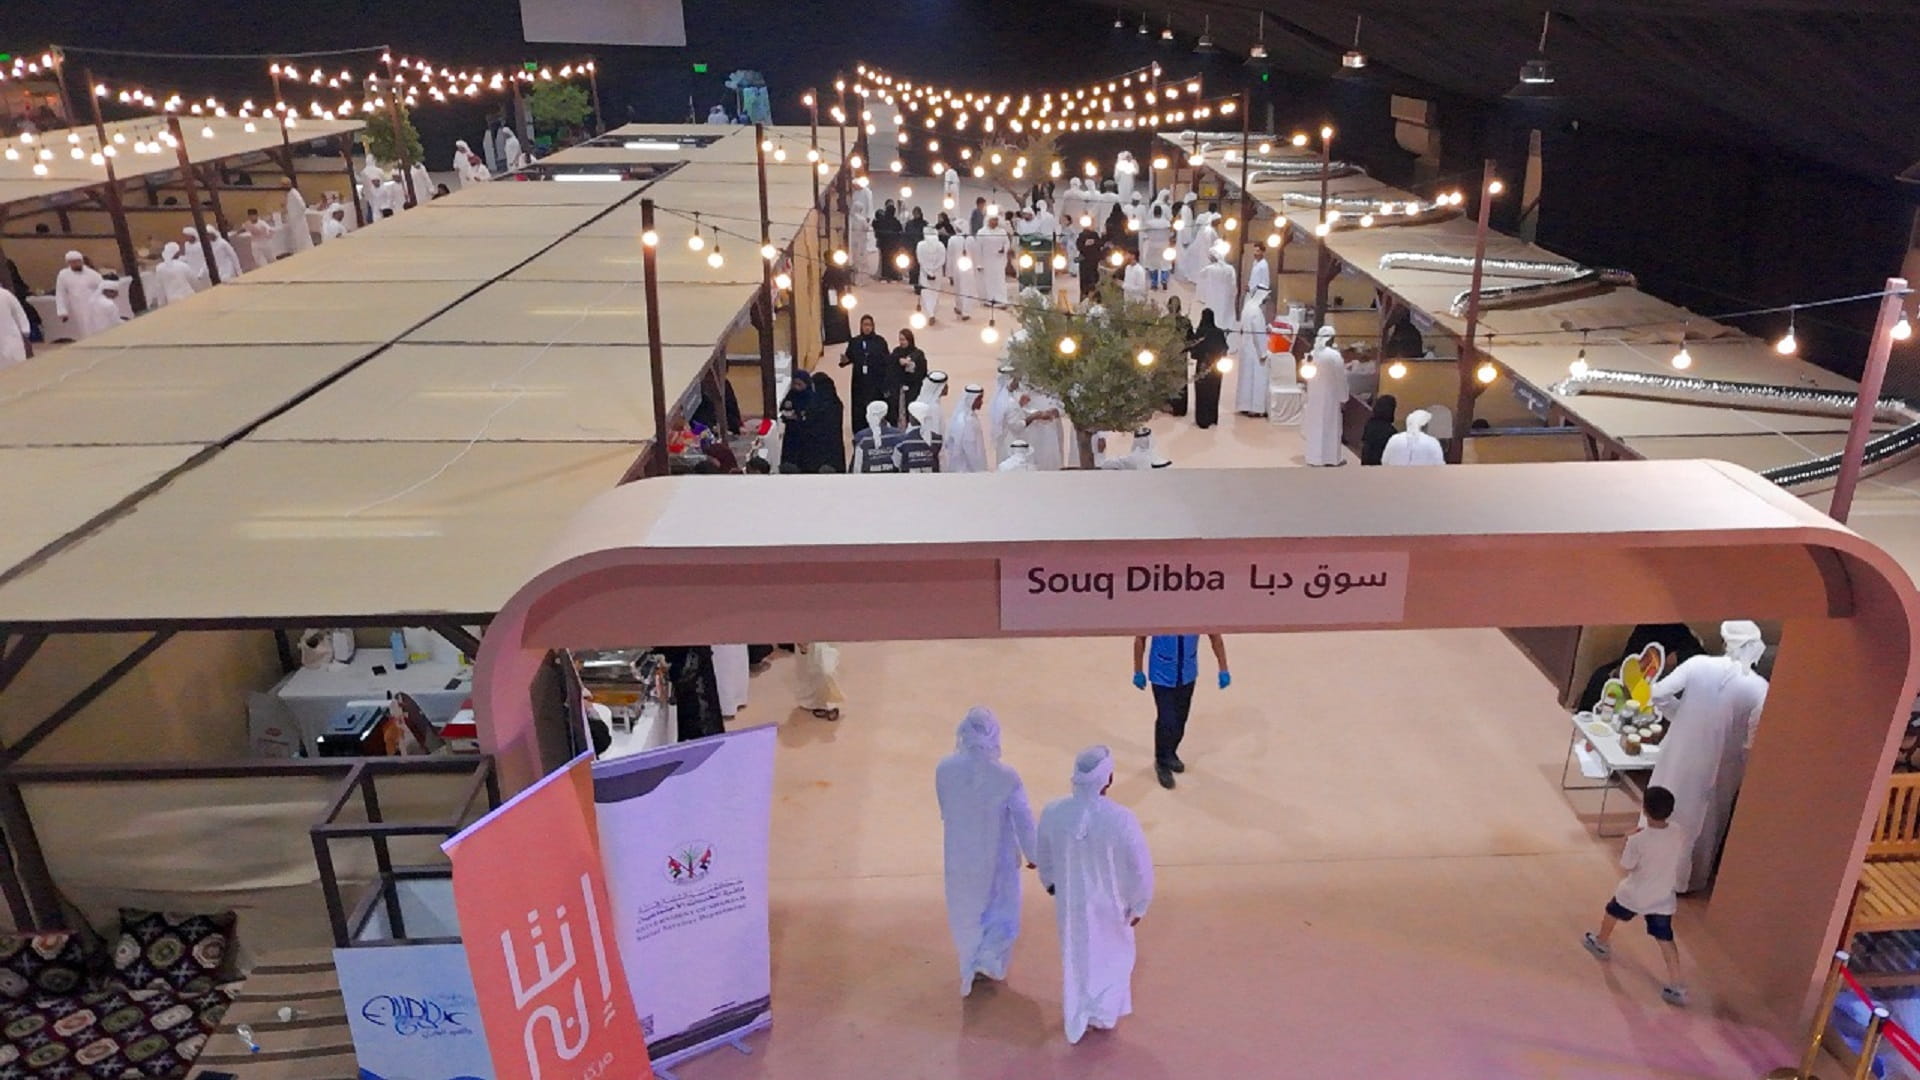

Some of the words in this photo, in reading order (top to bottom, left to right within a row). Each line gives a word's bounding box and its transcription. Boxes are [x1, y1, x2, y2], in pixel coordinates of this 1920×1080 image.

[1028, 566, 1115, 599] Souq
[1126, 563, 1226, 593] Dibba
[1249, 564, 1294, 596] دبا
[1303, 564, 1388, 598] سوق
